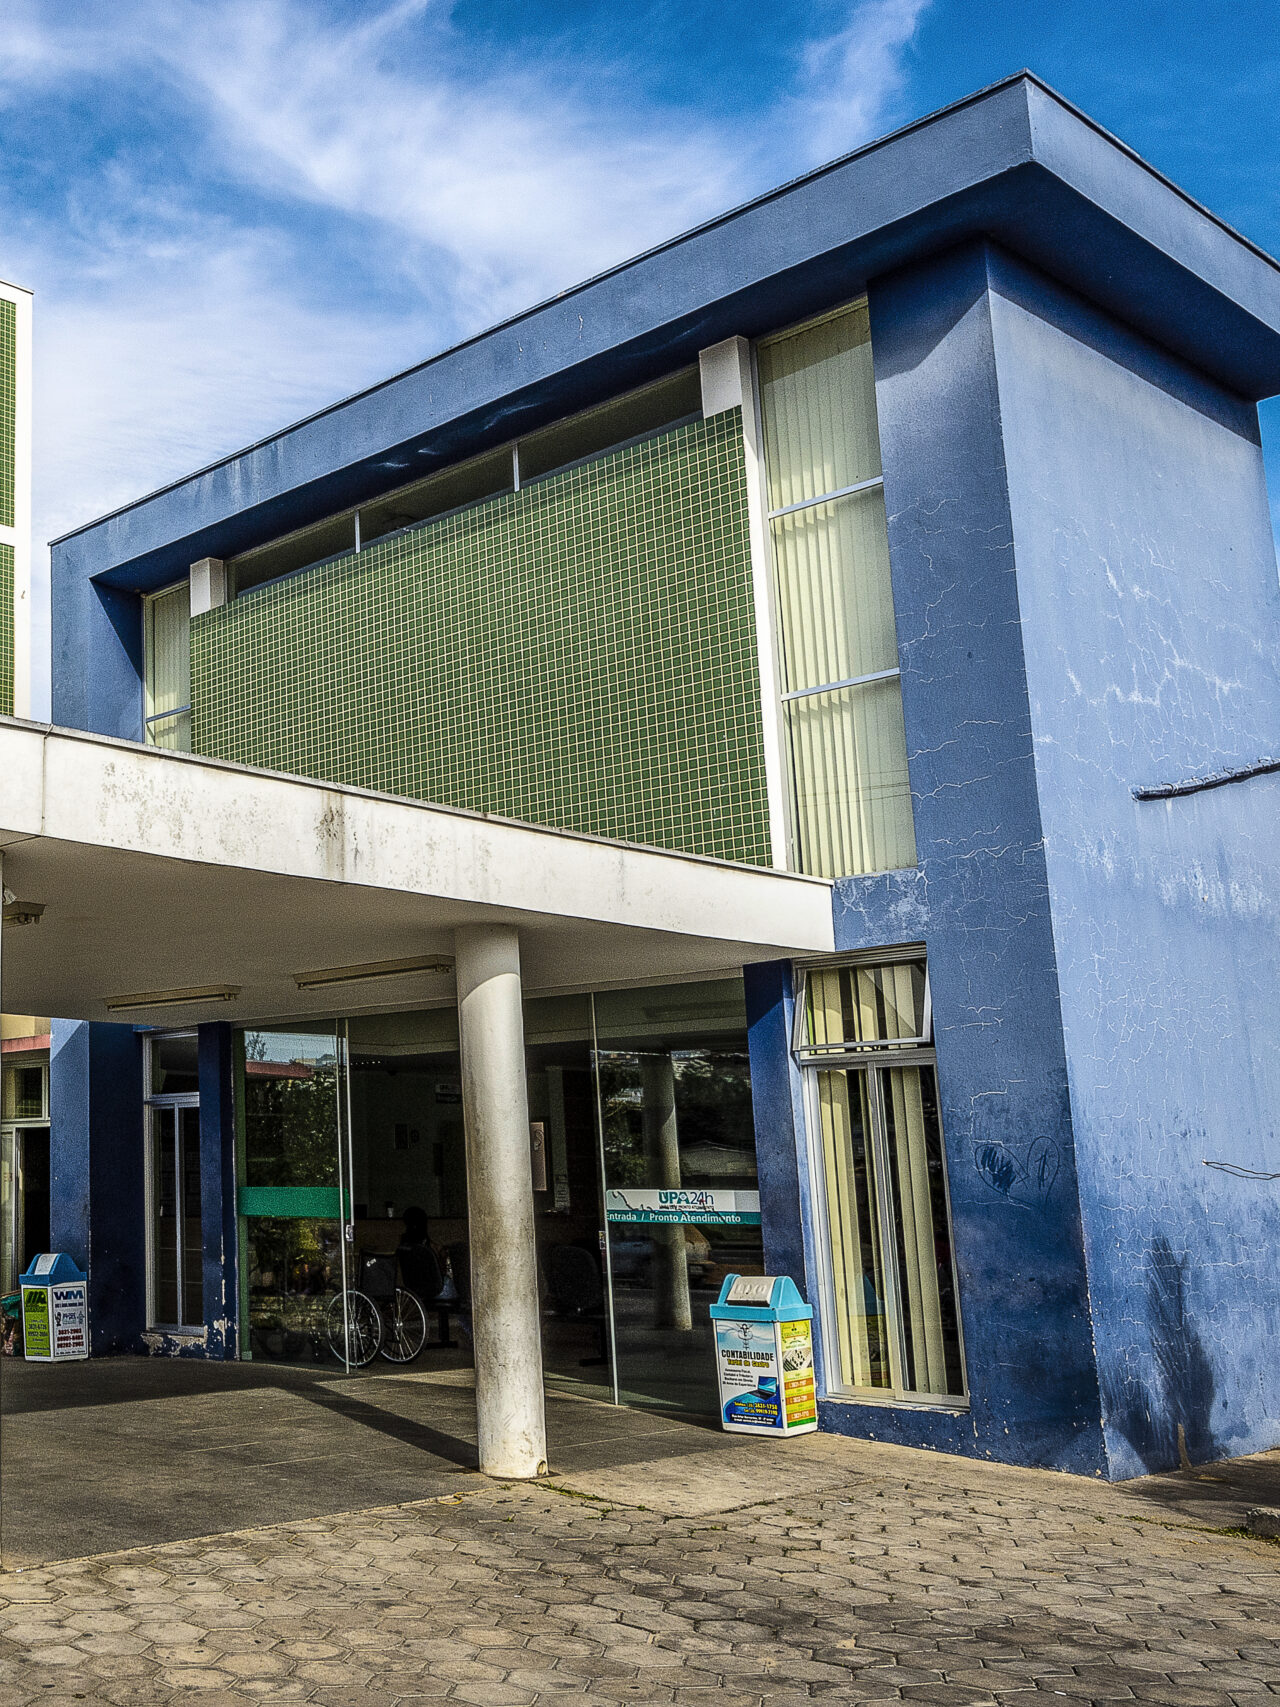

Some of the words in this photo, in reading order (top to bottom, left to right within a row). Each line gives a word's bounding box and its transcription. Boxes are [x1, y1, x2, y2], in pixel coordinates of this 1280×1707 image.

[658, 1191, 690, 1204] UPA
[690, 1191, 714, 1205] 24h
[649, 1213, 679, 1222] Pronto
[681, 1213, 741, 1223] Atendimento
[721, 1349, 774, 1362] CONTABILIDADE
